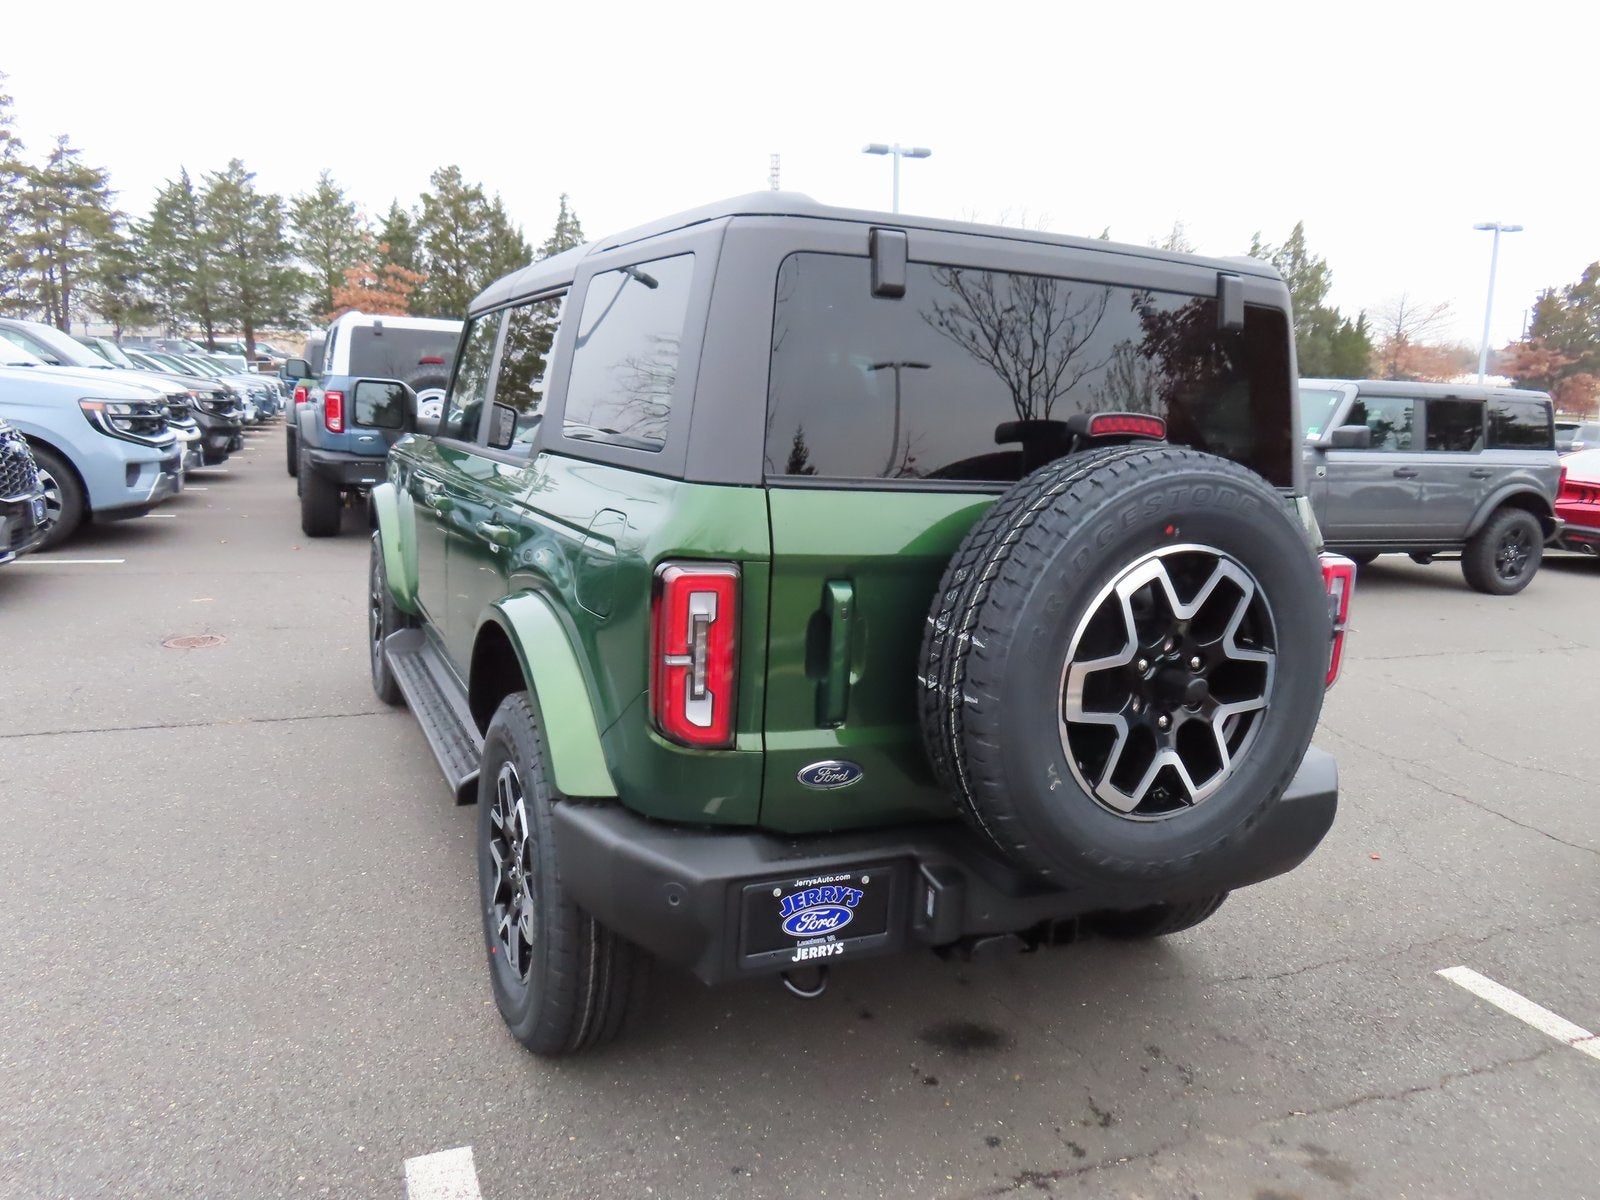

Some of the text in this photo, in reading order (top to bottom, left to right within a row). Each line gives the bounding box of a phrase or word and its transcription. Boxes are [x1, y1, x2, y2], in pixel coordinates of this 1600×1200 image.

[814, 767, 849, 783] Ford
[794, 874, 851, 887] JerrysAuto.com
[779, 886, 864, 918] JERRY'S
[796, 910, 841, 932] Ford
[791, 942, 844, 962] JERRY'S
